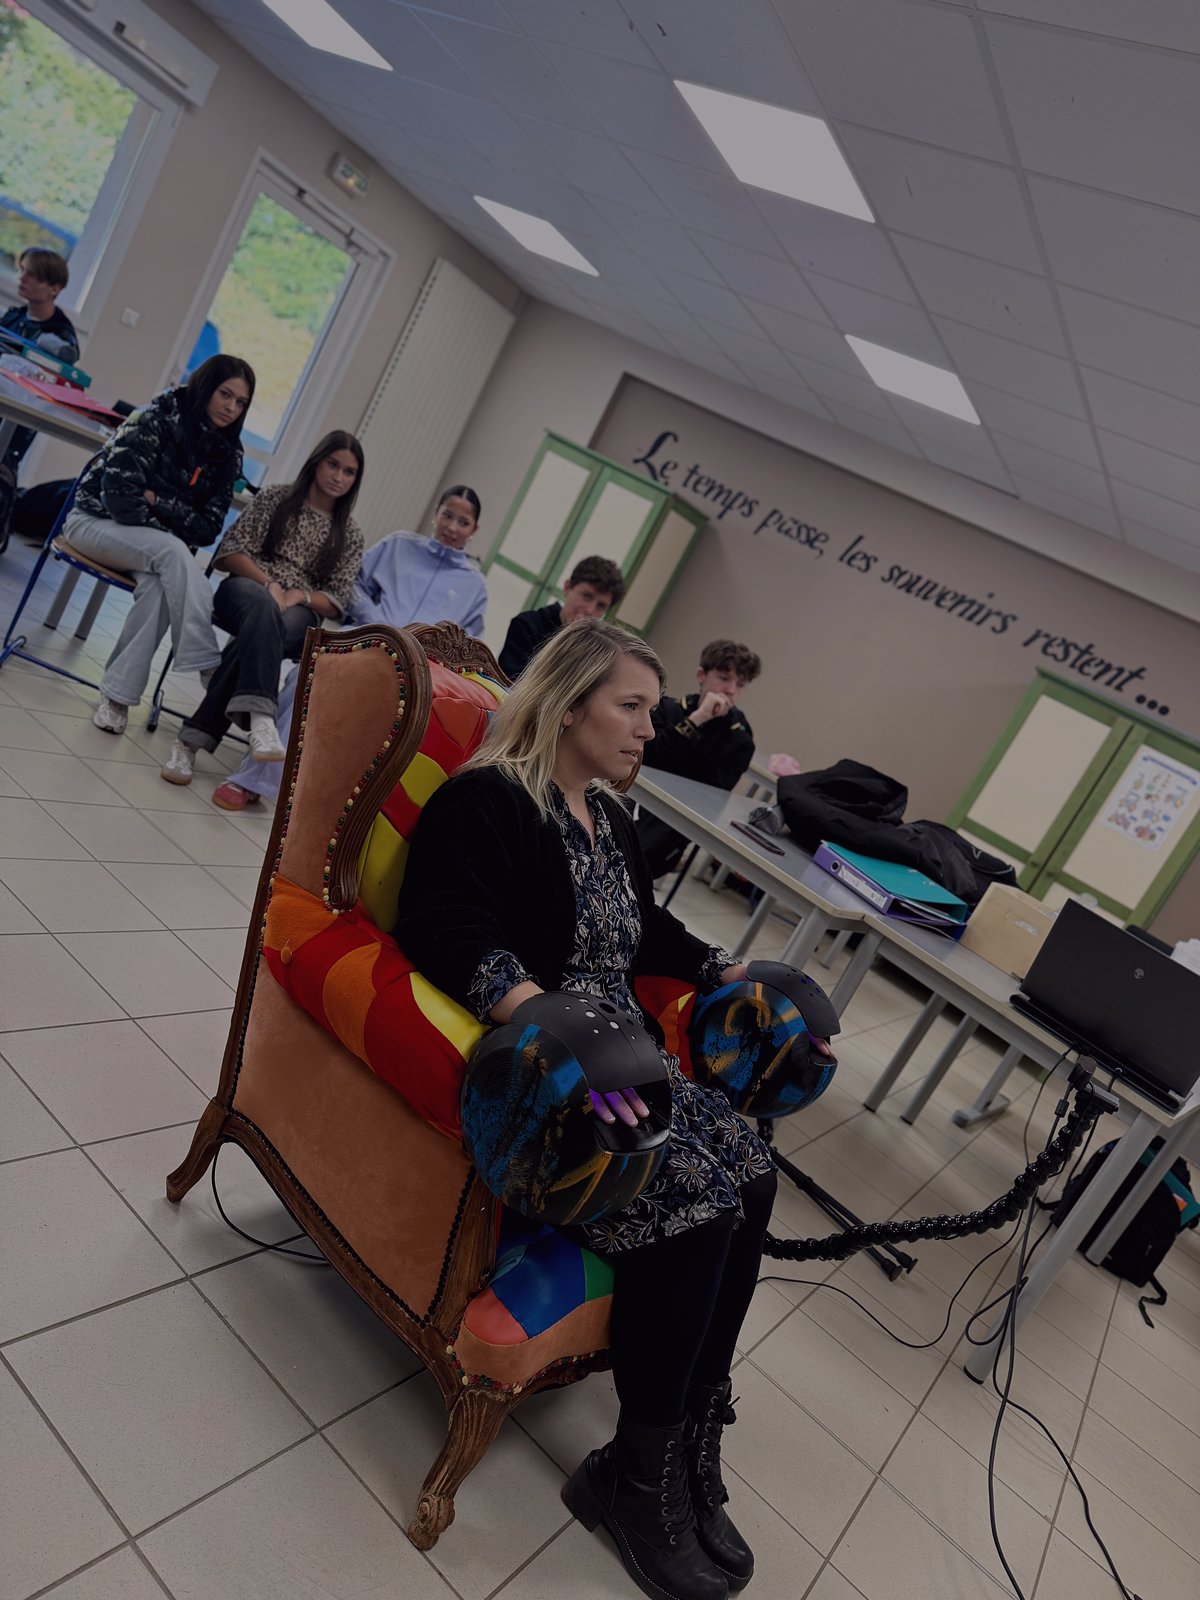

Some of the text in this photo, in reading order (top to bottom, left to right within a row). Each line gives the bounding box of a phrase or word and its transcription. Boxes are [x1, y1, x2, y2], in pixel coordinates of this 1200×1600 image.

[633, 431, 678, 484] Le
[682, 463, 759, 519] temps
[754, 509, 829, 558] passe,
[838, 535, 878, 573] les
[881, 564, 1018, 633] souvenirs
